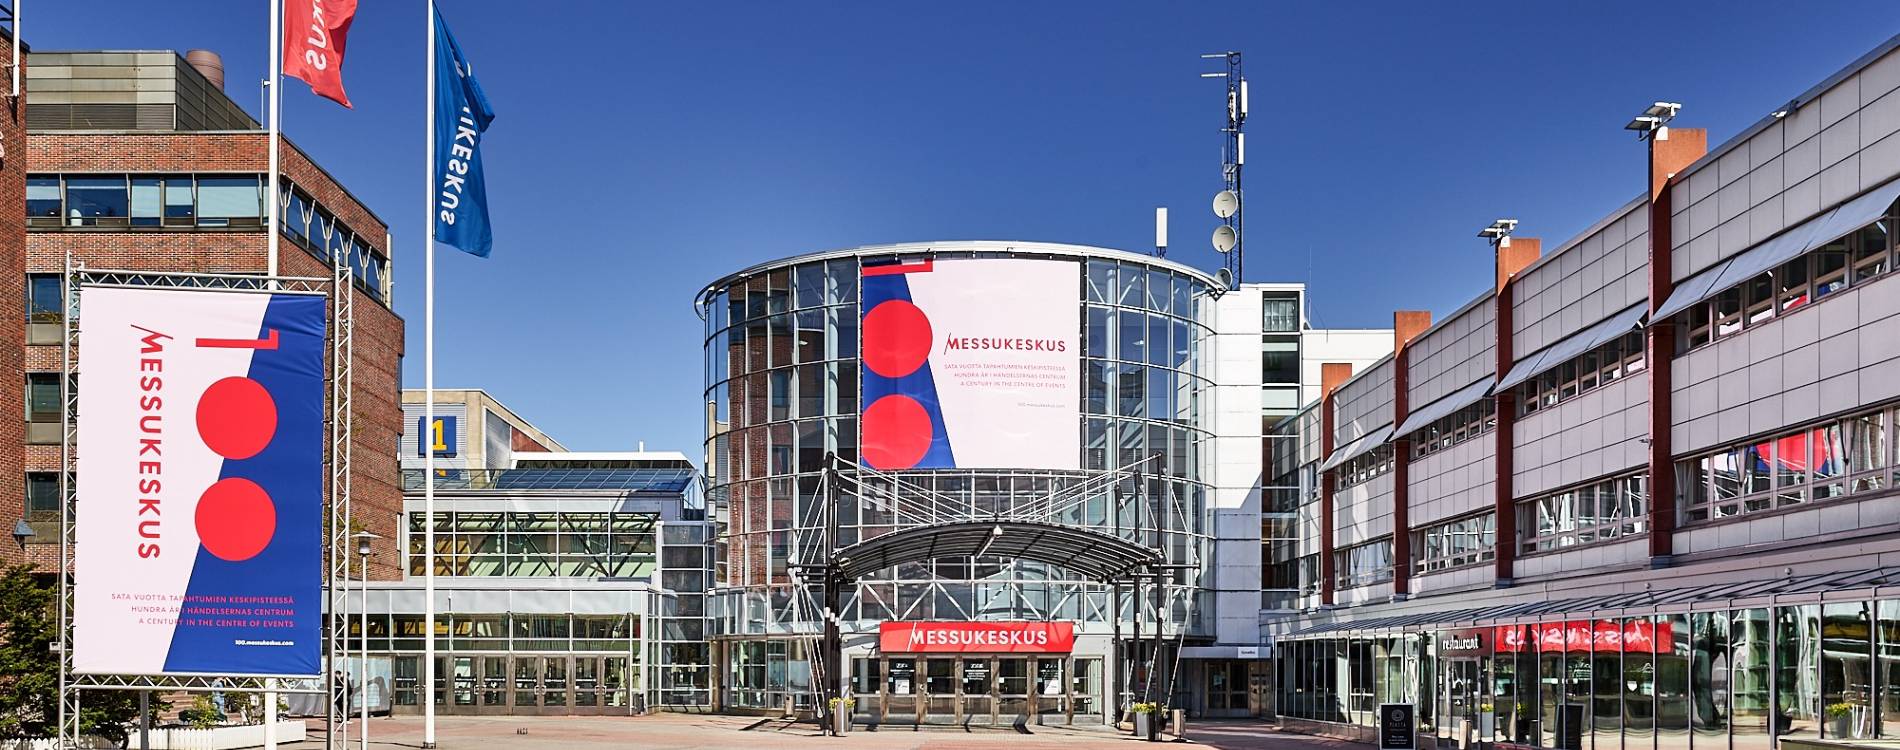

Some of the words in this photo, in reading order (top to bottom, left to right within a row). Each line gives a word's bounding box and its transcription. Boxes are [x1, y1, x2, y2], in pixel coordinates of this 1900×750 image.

[944, 332, 1066, 355] MESSUKESKUS
[132, 325, 172, 559] MESSUKESKUS
[432, 419, 447, 451] 1
[169, 595, 227, 604] TAPAHTUMIEN
[131, 605, 167, 613] HUNDRA
[254, 608, 294, 616] CENTRUM
[198, 619, 213, 627] THE
[249, 620, 261, 628] OF
[263, 620, 294, 628] EVENTS
[907, 623, 1047, 651] MESSUKESKUS
[1442, 633, 1479, 650] restaurant
